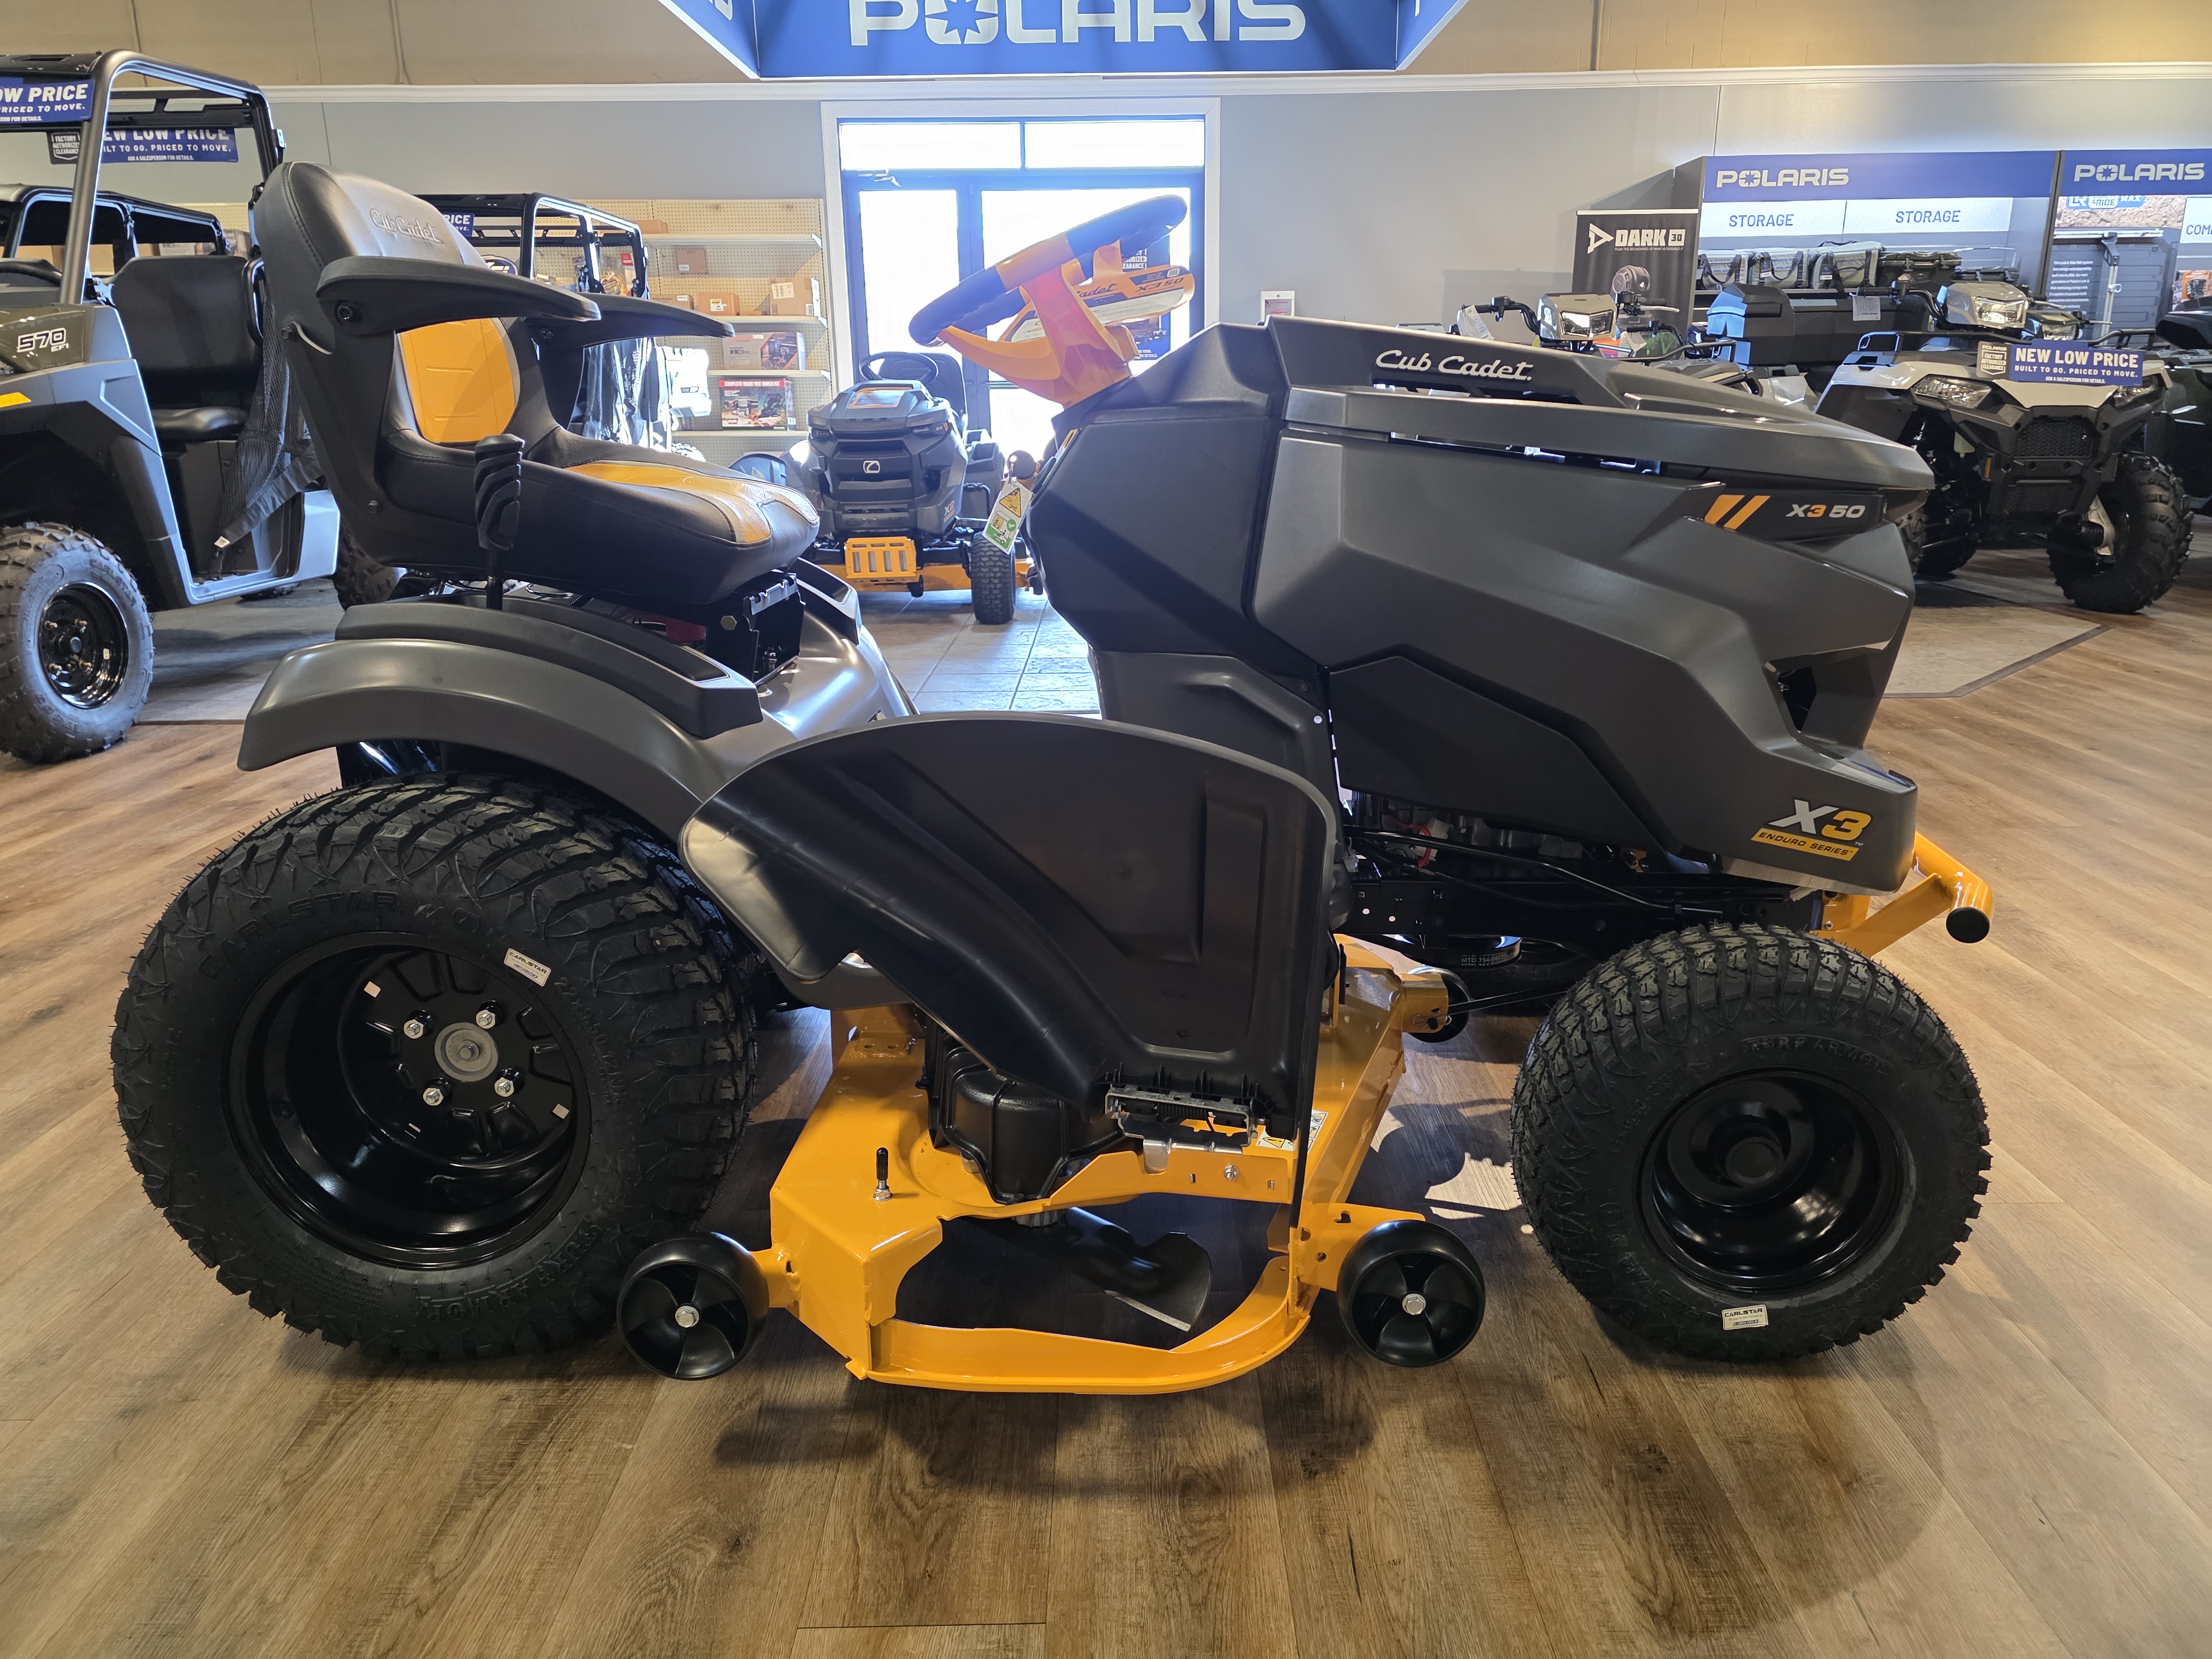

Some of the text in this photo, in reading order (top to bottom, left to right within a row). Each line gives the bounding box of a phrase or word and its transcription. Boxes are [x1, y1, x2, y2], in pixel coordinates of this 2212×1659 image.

[849, 0, 1306, 46] POLARIS
[28, 84, 88, 102] PRICE
[54, 103, 85, 111] MOVE.
[133, 129, 168, 141] LOW
[175, 128, 229, 140] PRICE
[1717, 168, 1849, 188] POLARIS
[2074, 163, 2205, 182] POLARIS
[369, 208, 397, 233] Cub
[443, 214, 470, 225] RICE
[1729, 214, 1794, 227] STORAGE
[1895, 210, 1961, 223] STORAGE
[1615, 229, 1667, 247] DARK
[17, 327, 66, 353] 570
[51, 343, 69, 352] EFI
[1376, 349, 1432, 371] Cub
[2016, 348, 2138, 368] NEW LOW PRICE
[1785, 504, 1865, 518] X3 50
[1768, 799, 1871, 841] X3
[1759, 832, 1807, 847] ENDURO
[197, 889, 401, 982] CARLSTAR
[509, 952, 547, 974] CARLSTAR
[1725, 1308, 1762, 1317] CARLSTAR
